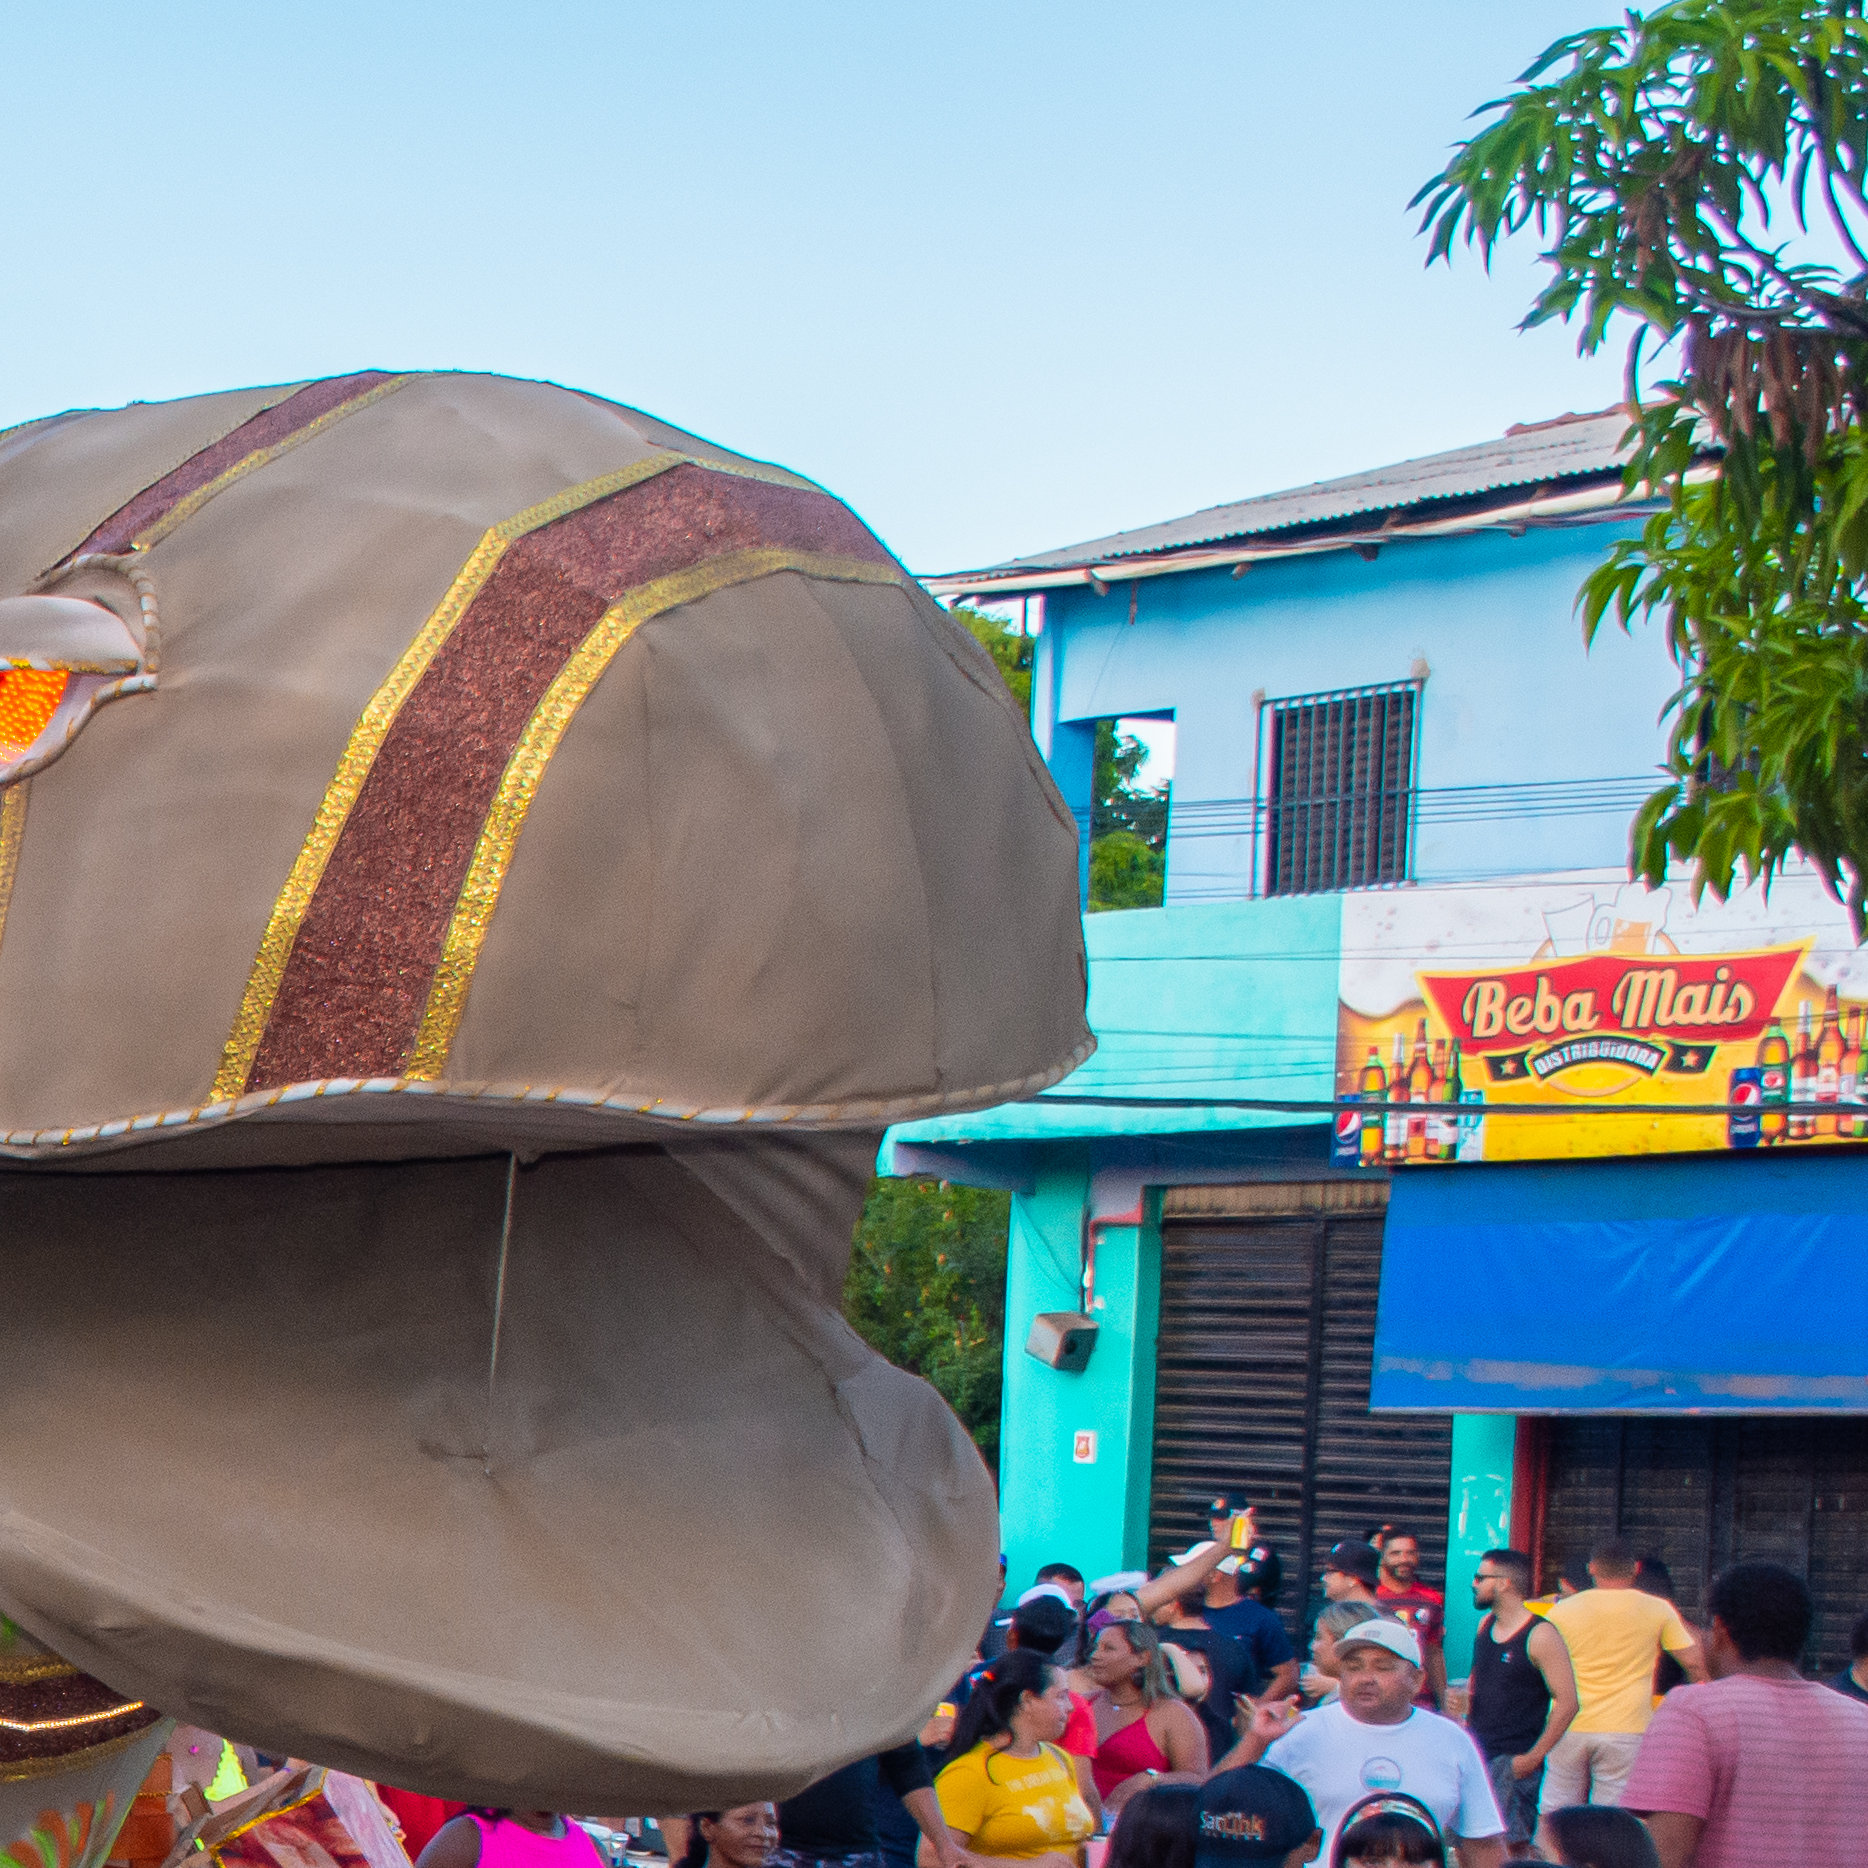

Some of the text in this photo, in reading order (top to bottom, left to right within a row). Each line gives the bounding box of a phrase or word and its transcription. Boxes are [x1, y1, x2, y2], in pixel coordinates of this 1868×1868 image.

[1462, 964, 1756, 1038] Beba Mais
[1532, 1040, 1660, 1075] DISTRIBUIDORA
